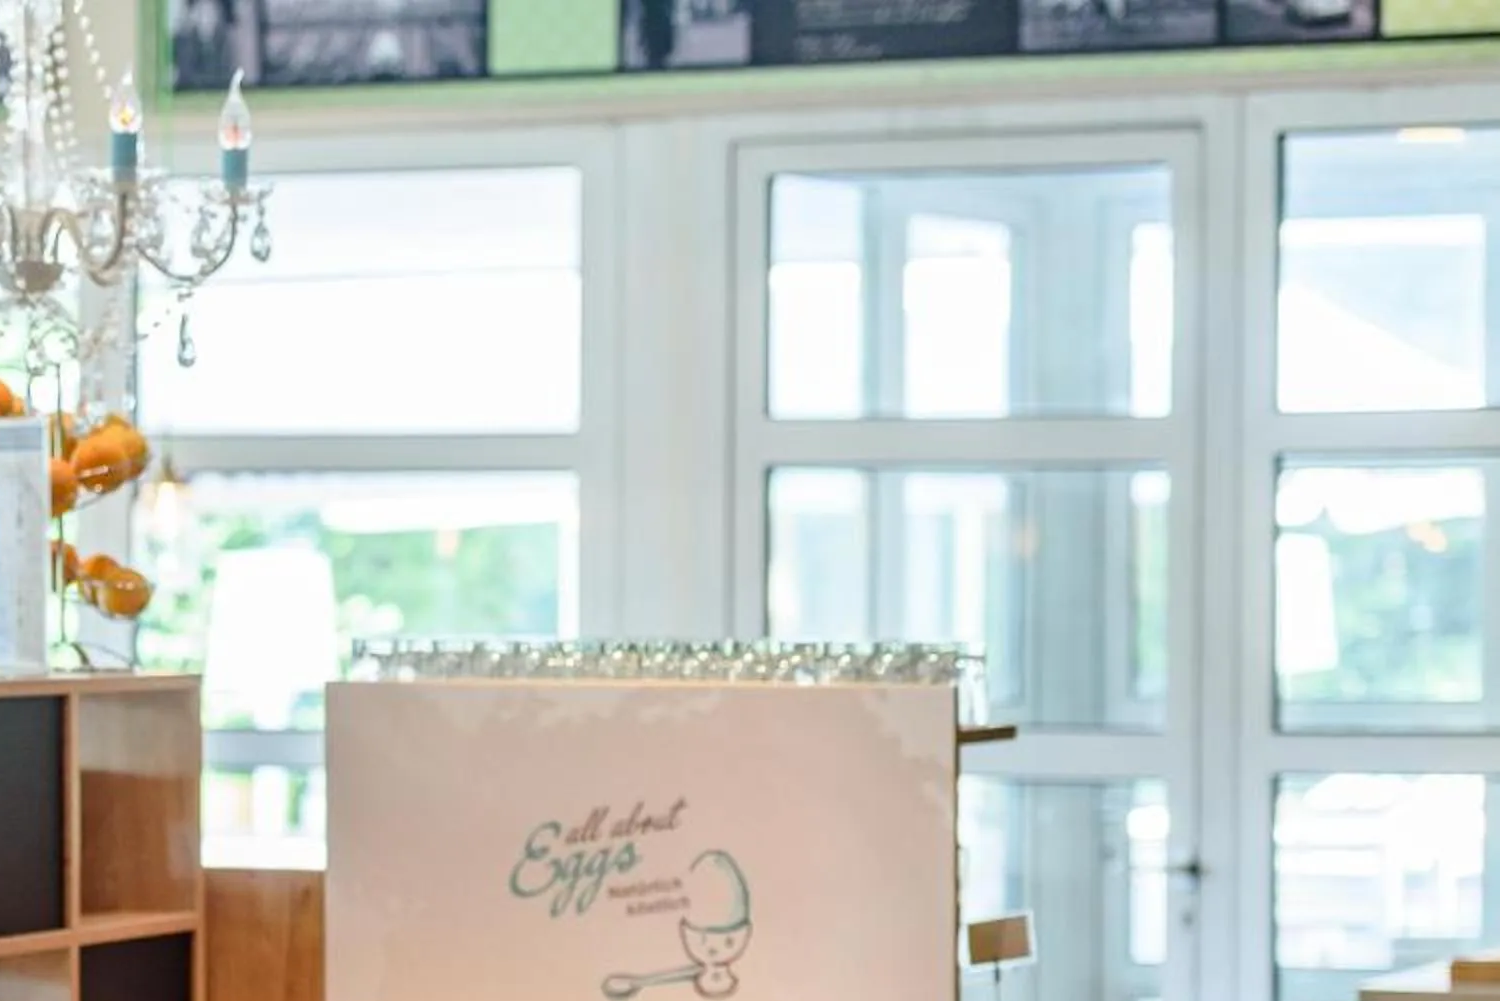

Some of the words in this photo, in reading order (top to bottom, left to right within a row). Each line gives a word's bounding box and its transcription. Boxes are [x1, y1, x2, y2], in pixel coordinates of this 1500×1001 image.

[565, 806, 610, 843] all
[610, 798, 687, 838] about
[510, 821, 639, 917] Eggs
